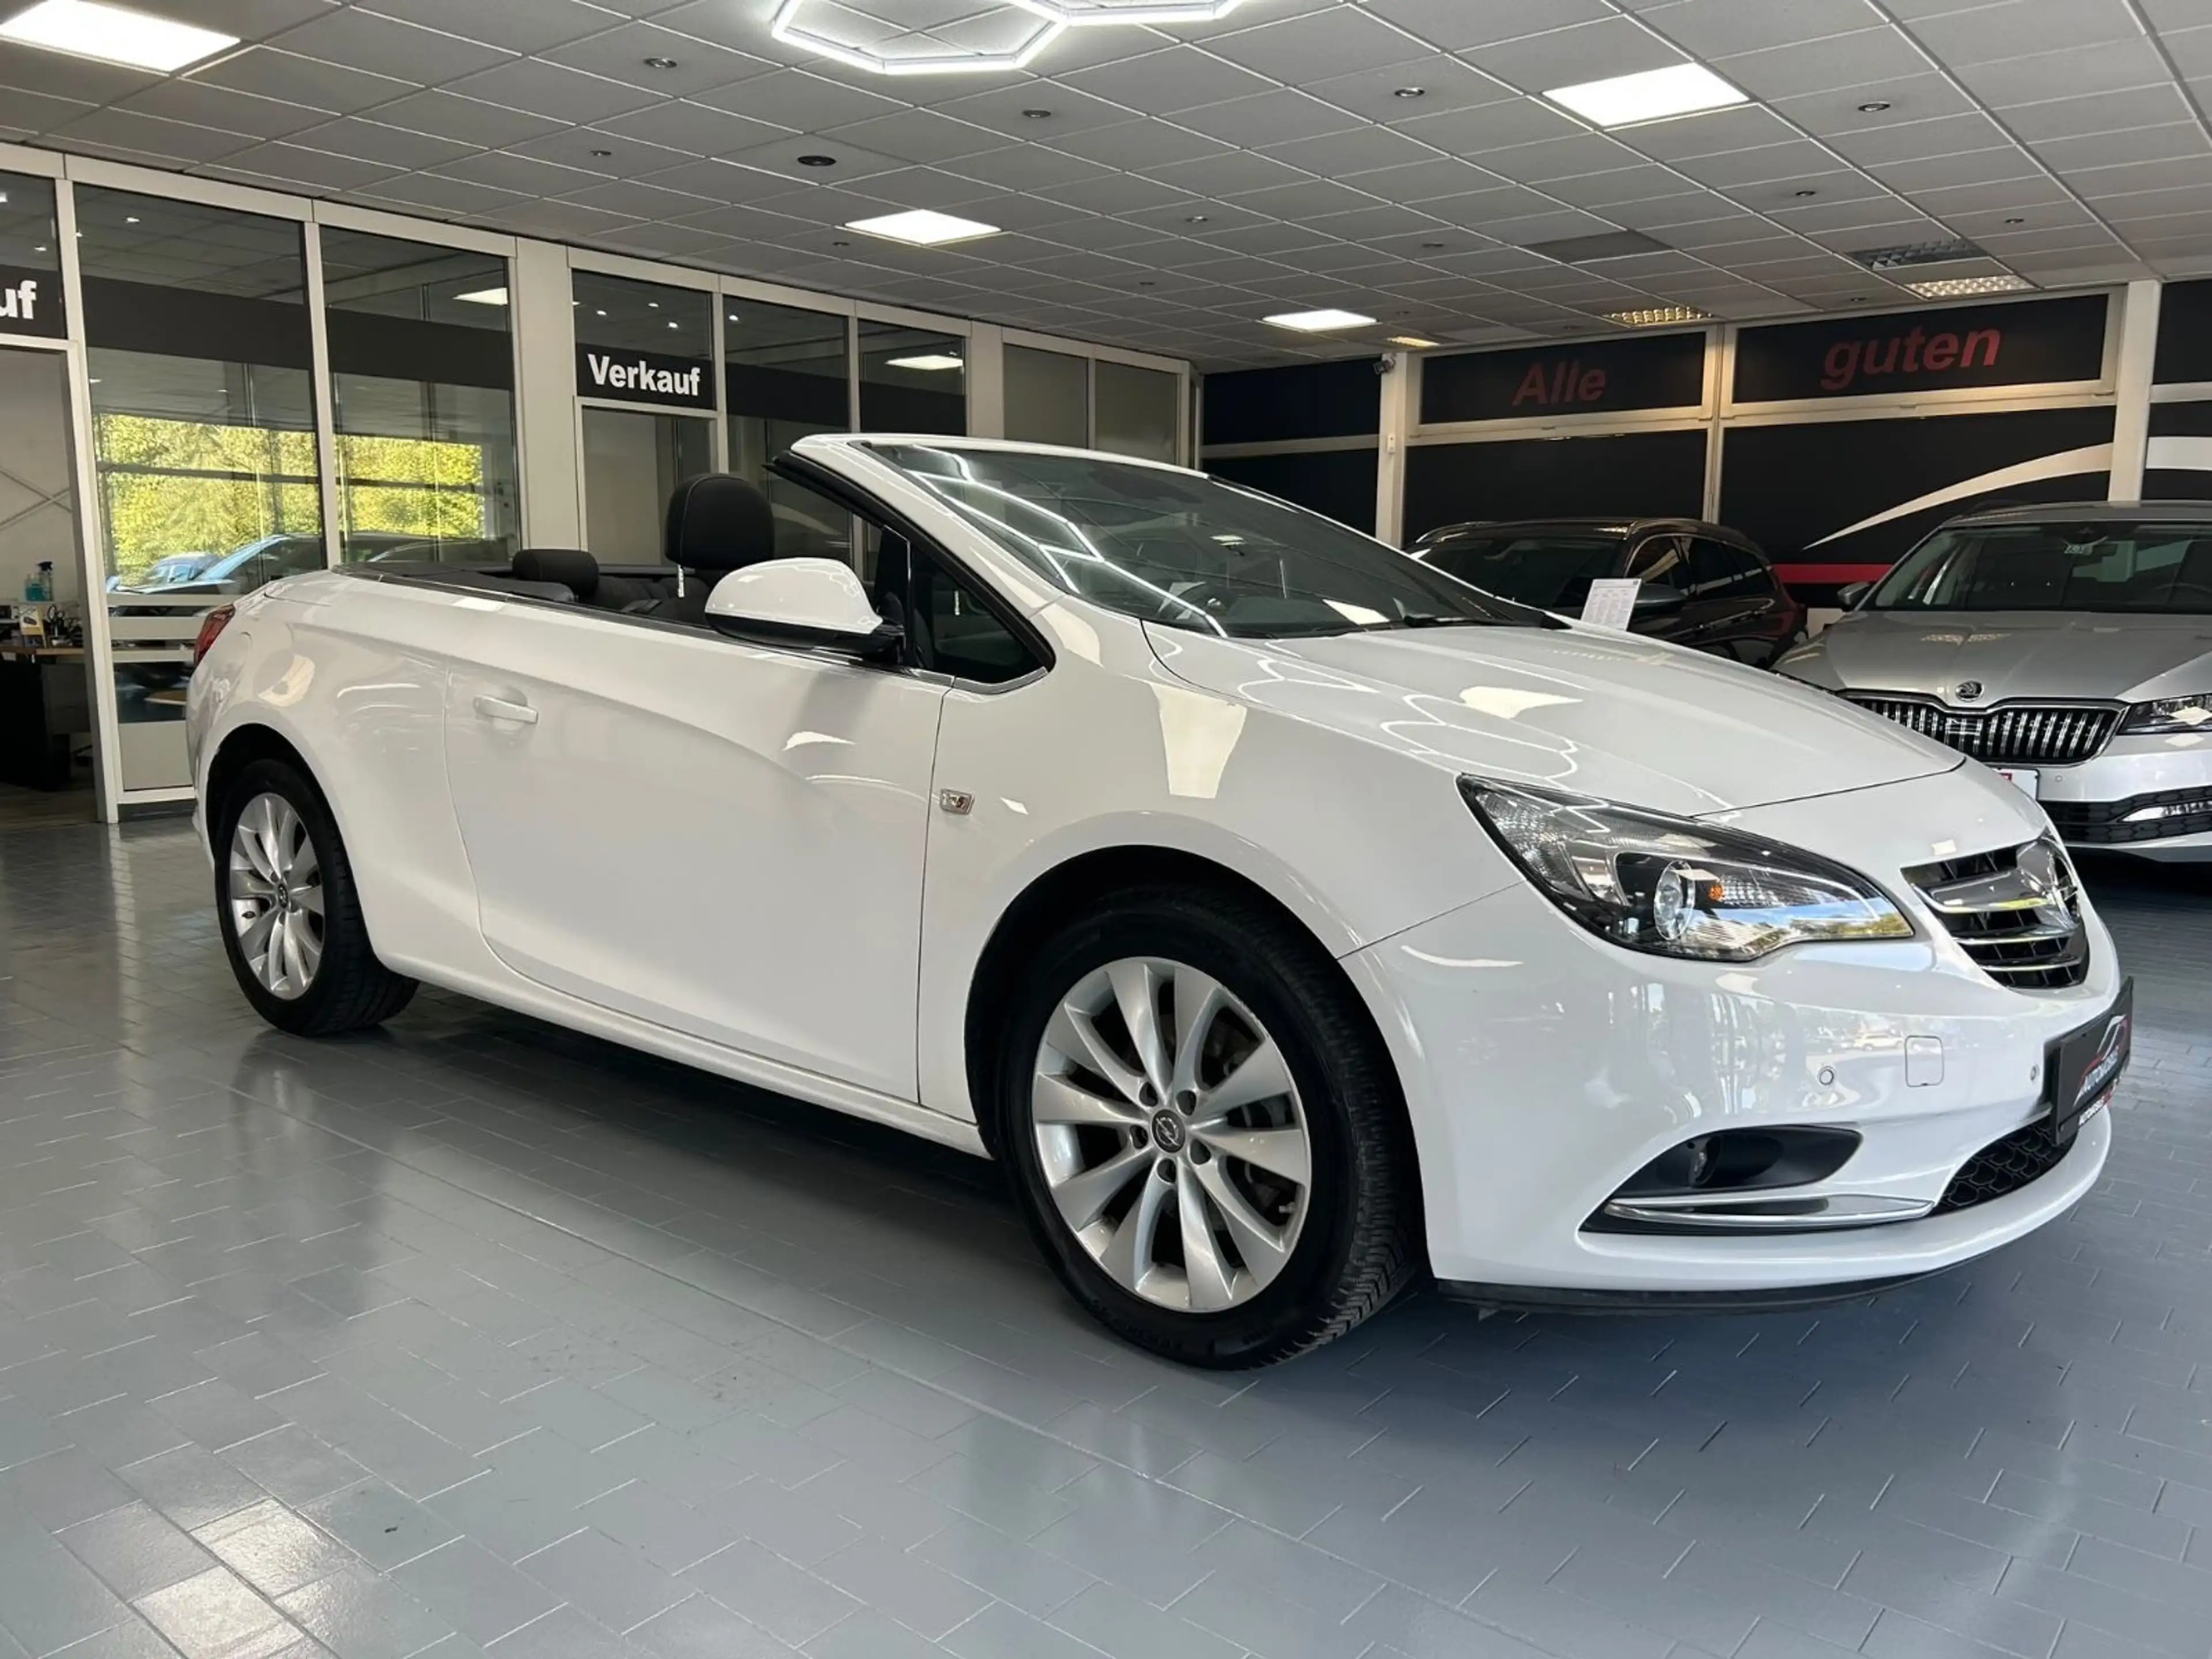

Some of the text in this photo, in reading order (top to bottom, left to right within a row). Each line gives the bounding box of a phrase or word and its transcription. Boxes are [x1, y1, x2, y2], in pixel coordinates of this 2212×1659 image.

[587, 353, 701, 396] Verkauf
[1820, 325, 2001, 391] guten
[1511, 359, 1607, 407] Alle
